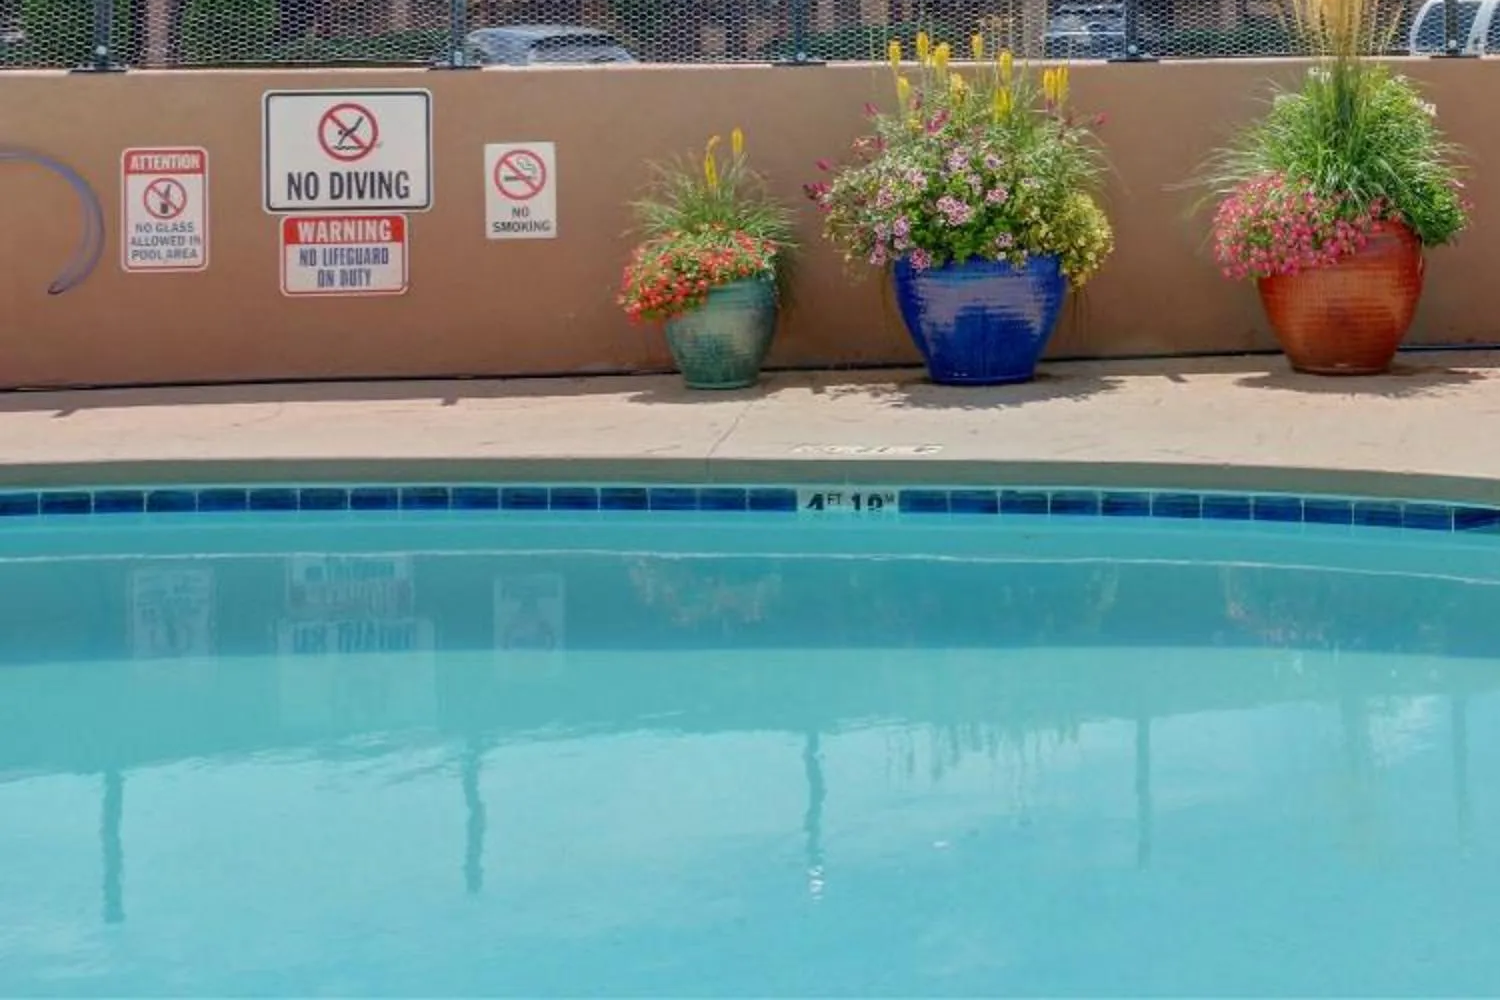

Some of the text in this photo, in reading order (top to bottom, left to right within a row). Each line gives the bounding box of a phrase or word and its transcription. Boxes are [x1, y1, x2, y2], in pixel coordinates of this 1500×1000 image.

[129, 155, 200, 170] ATTENTION
[287, 170, 410, 200] NO DIVING
[512, 206, 530, 217] NO
[135, 221, 194, 233] NO GLASS
[297, 219, 392, 243] WARNING
[492, 220, 551, 232] SMOKING
[131, 235, 201, 247] ALLOWED IN
[131, 247, 198, 260] POOL AREA
[299, 247, 389, 266] NO LIFEGUARD
[317, 268, 371, 288] ON DUTY
